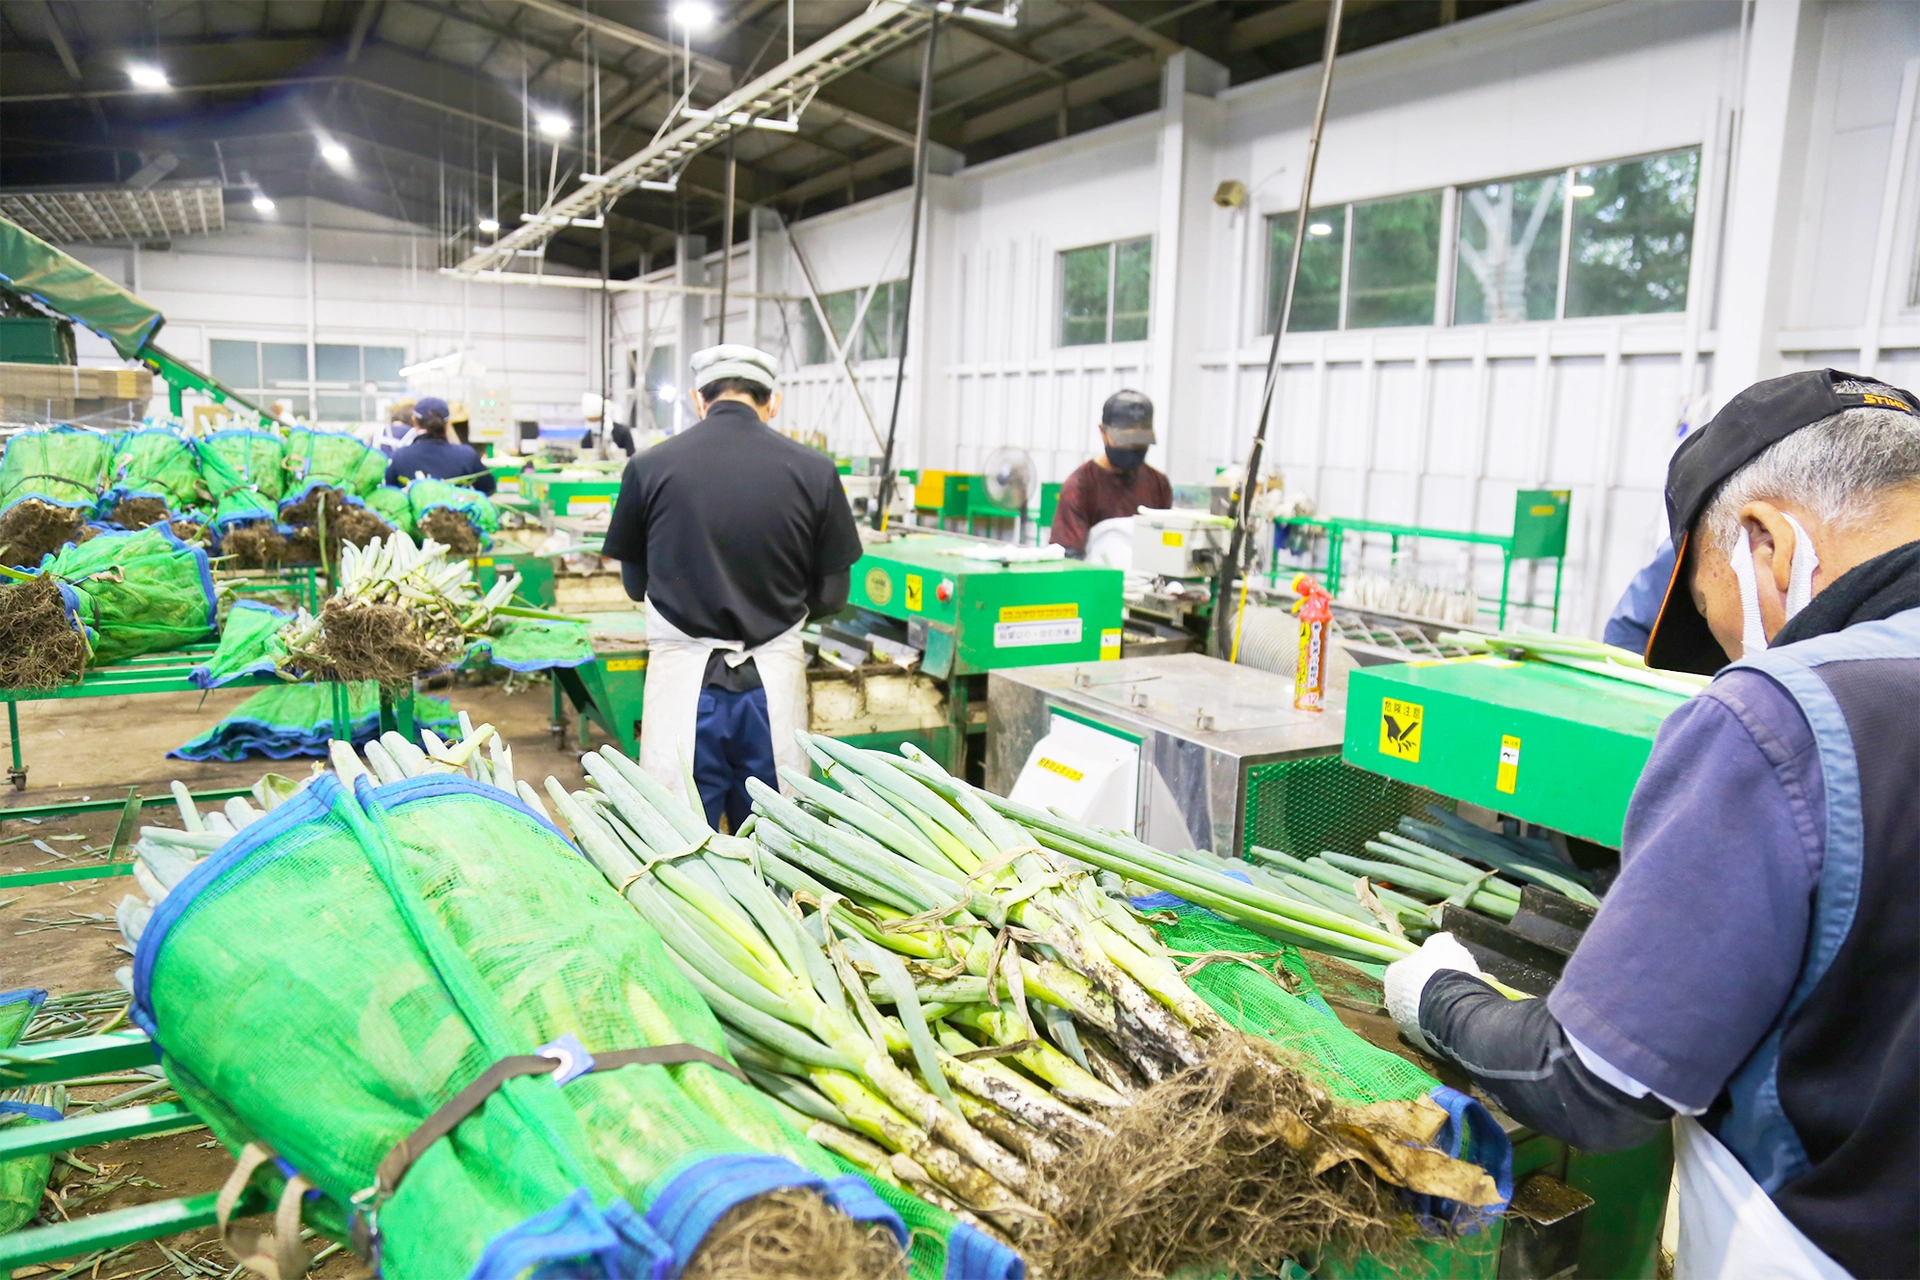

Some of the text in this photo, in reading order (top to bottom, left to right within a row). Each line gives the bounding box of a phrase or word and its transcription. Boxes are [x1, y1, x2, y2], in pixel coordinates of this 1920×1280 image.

[1864, 394, 1911, 412] STIHL
[1384, 700, 1422, 719] 危険注意
